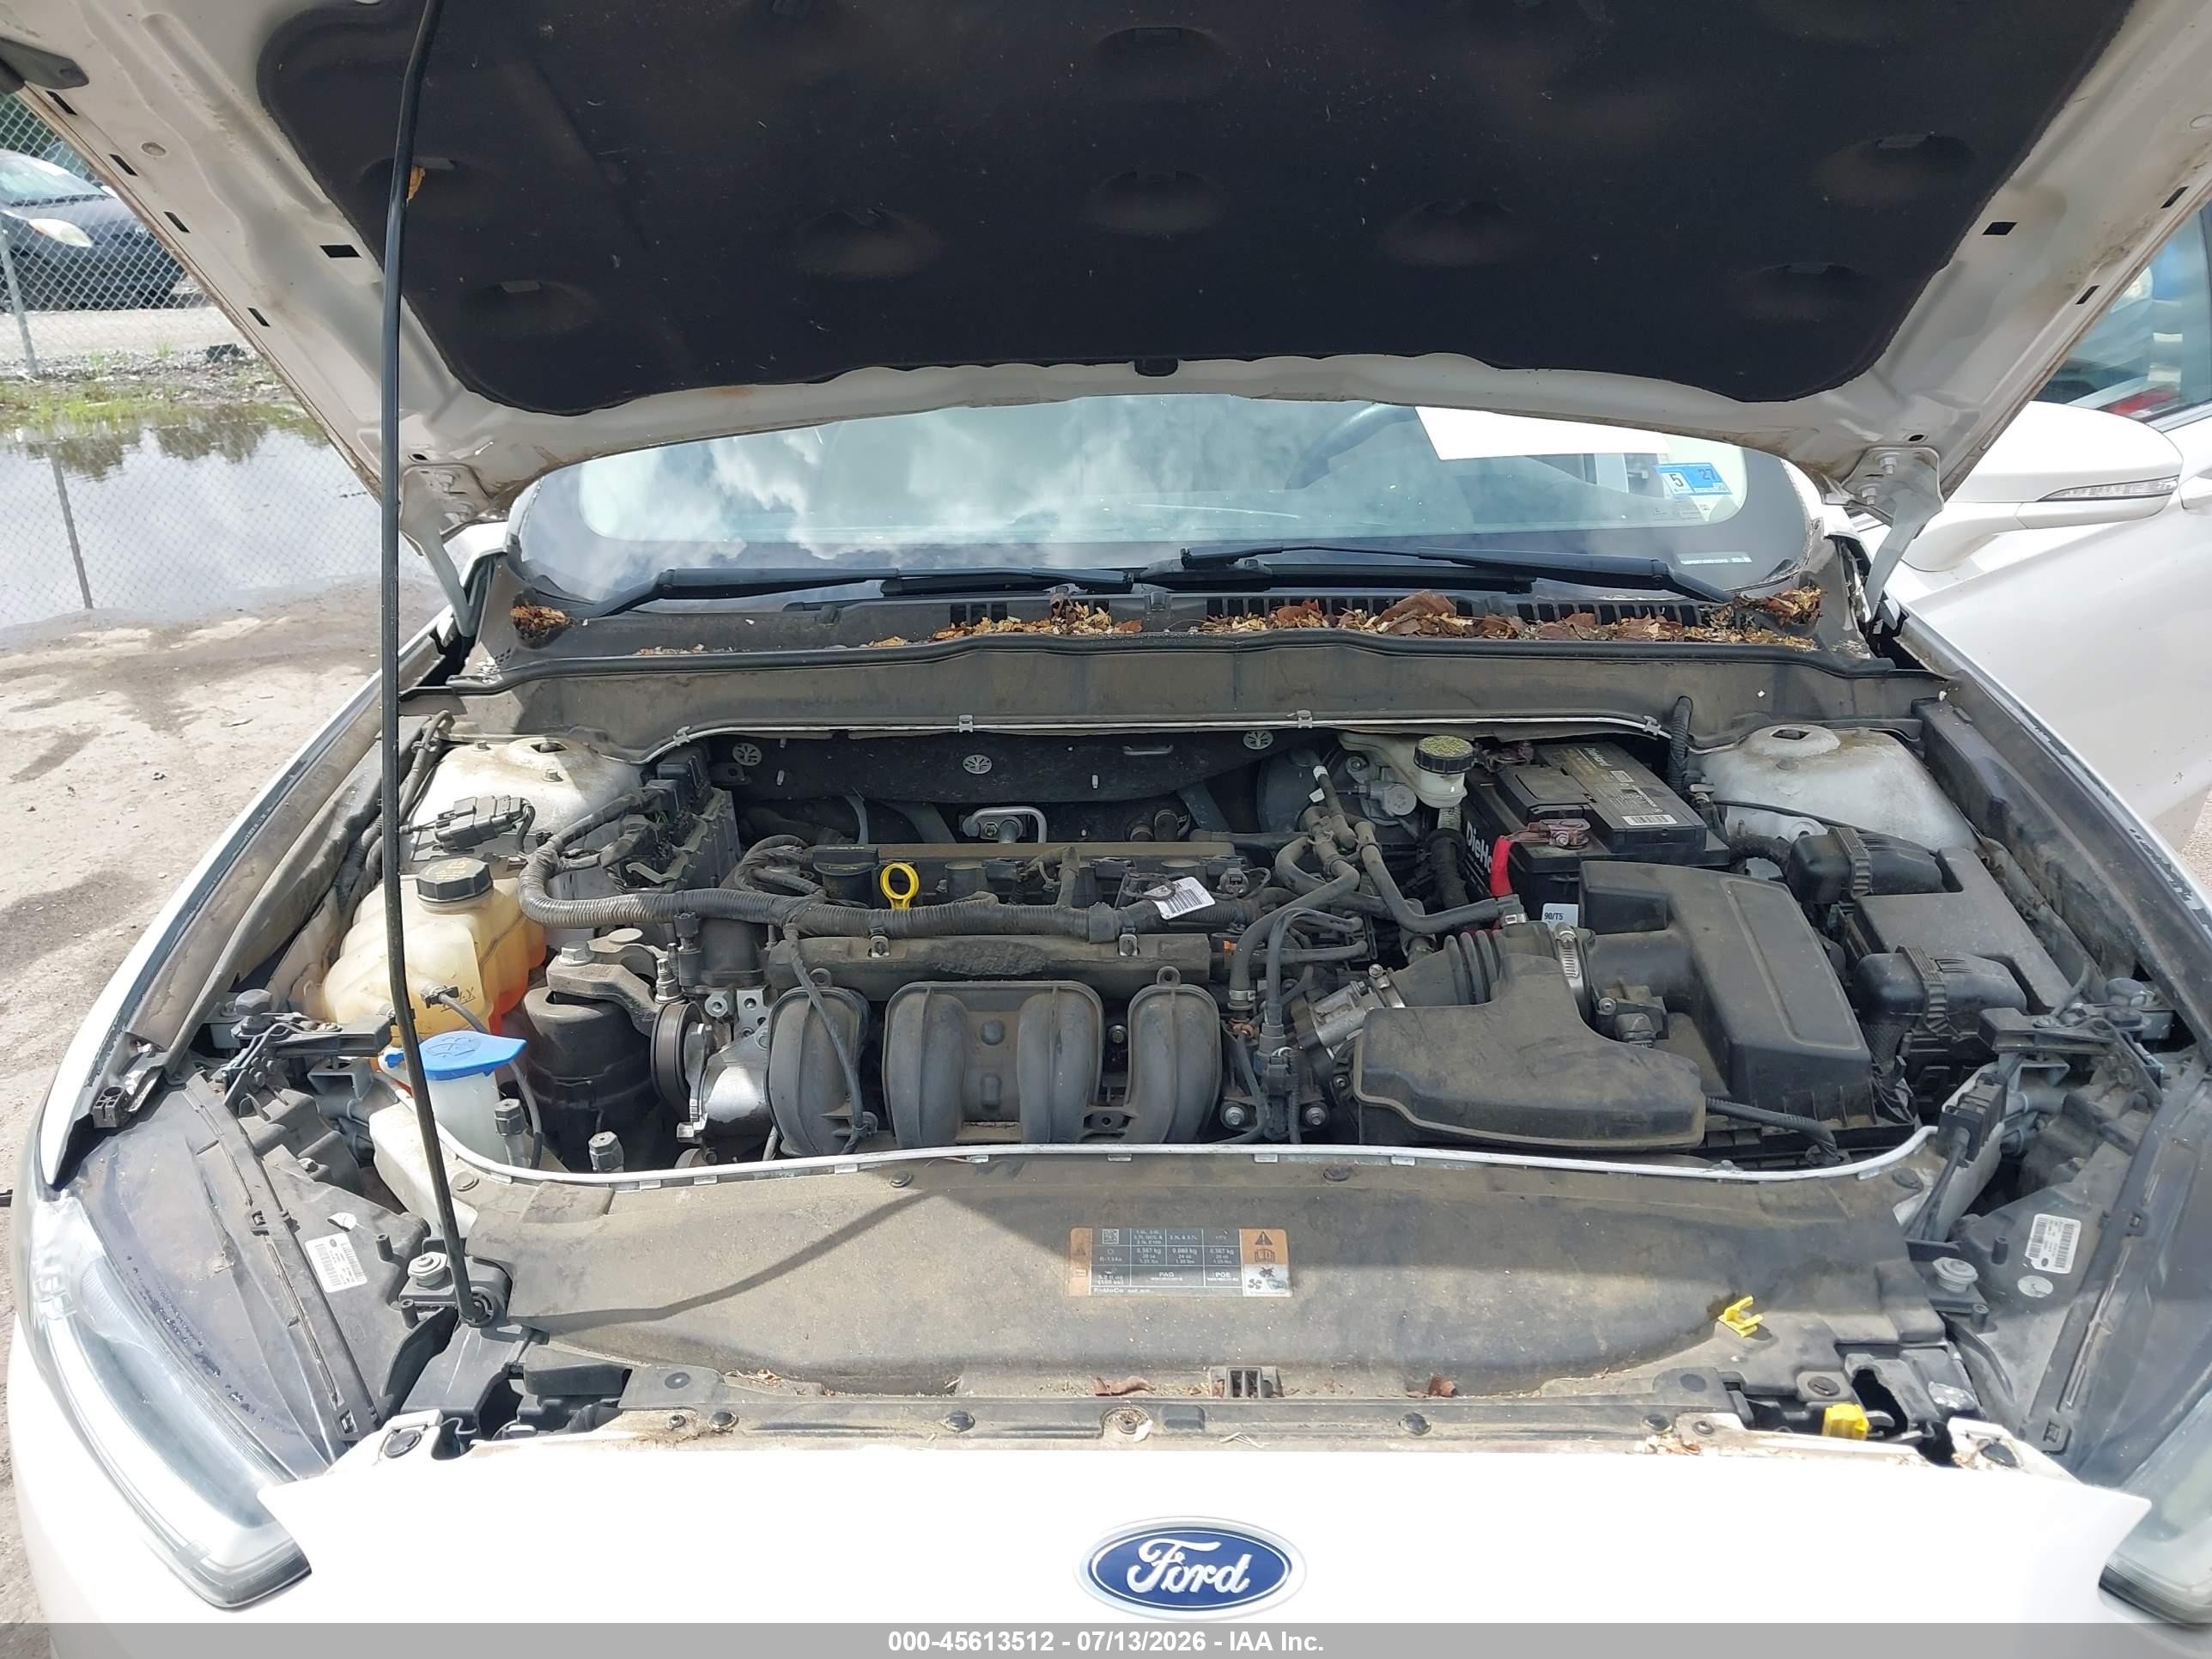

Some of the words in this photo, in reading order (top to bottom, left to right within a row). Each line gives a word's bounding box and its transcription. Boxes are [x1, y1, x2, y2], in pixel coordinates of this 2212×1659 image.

[1668, 473, 1684, 488] 5
[1698, 468, 1716, 480] 27
[1127, 1538, 1253, 1594] Ford
